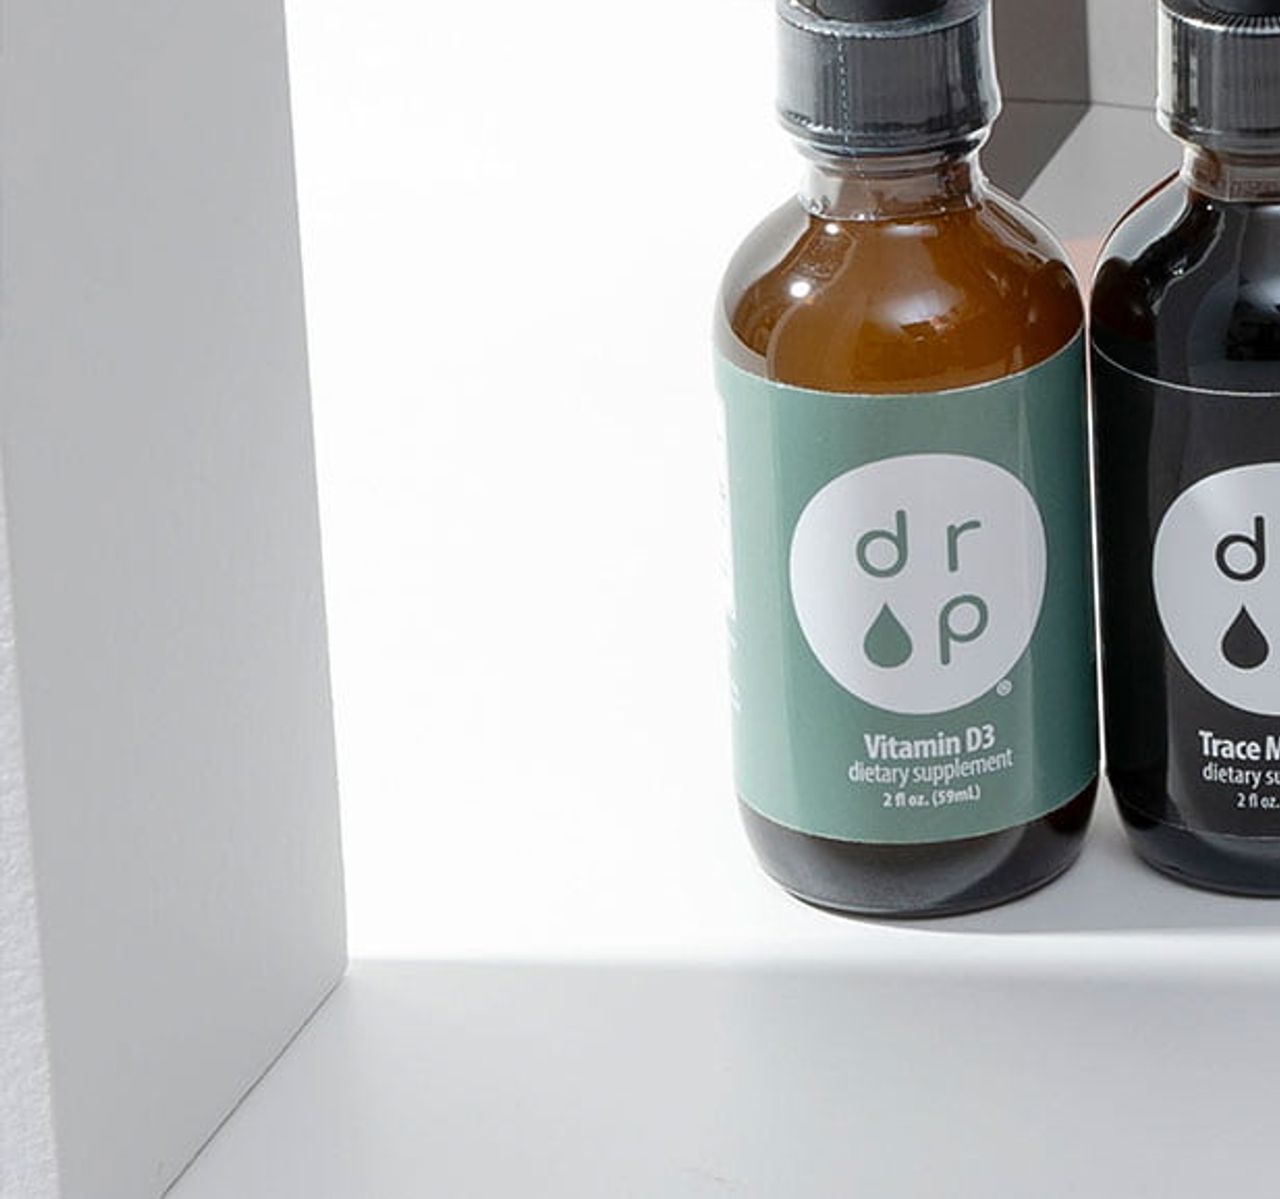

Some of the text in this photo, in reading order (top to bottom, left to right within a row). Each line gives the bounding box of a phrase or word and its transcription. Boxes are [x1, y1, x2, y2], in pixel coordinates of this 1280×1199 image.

[863, 723, 996, 760] Vitamin D3
[1198, 729, 1261, 761] Trace
[848, 748, 1014, 788] dietary supplement
[1202, 761, 1262, 790] dietary
[882, 792, 892, 807] 2
[894, 791, 906, 807] fl
[931, 784, 981, 808] (59mL)
[1236, 792, 1246, 808] 2
